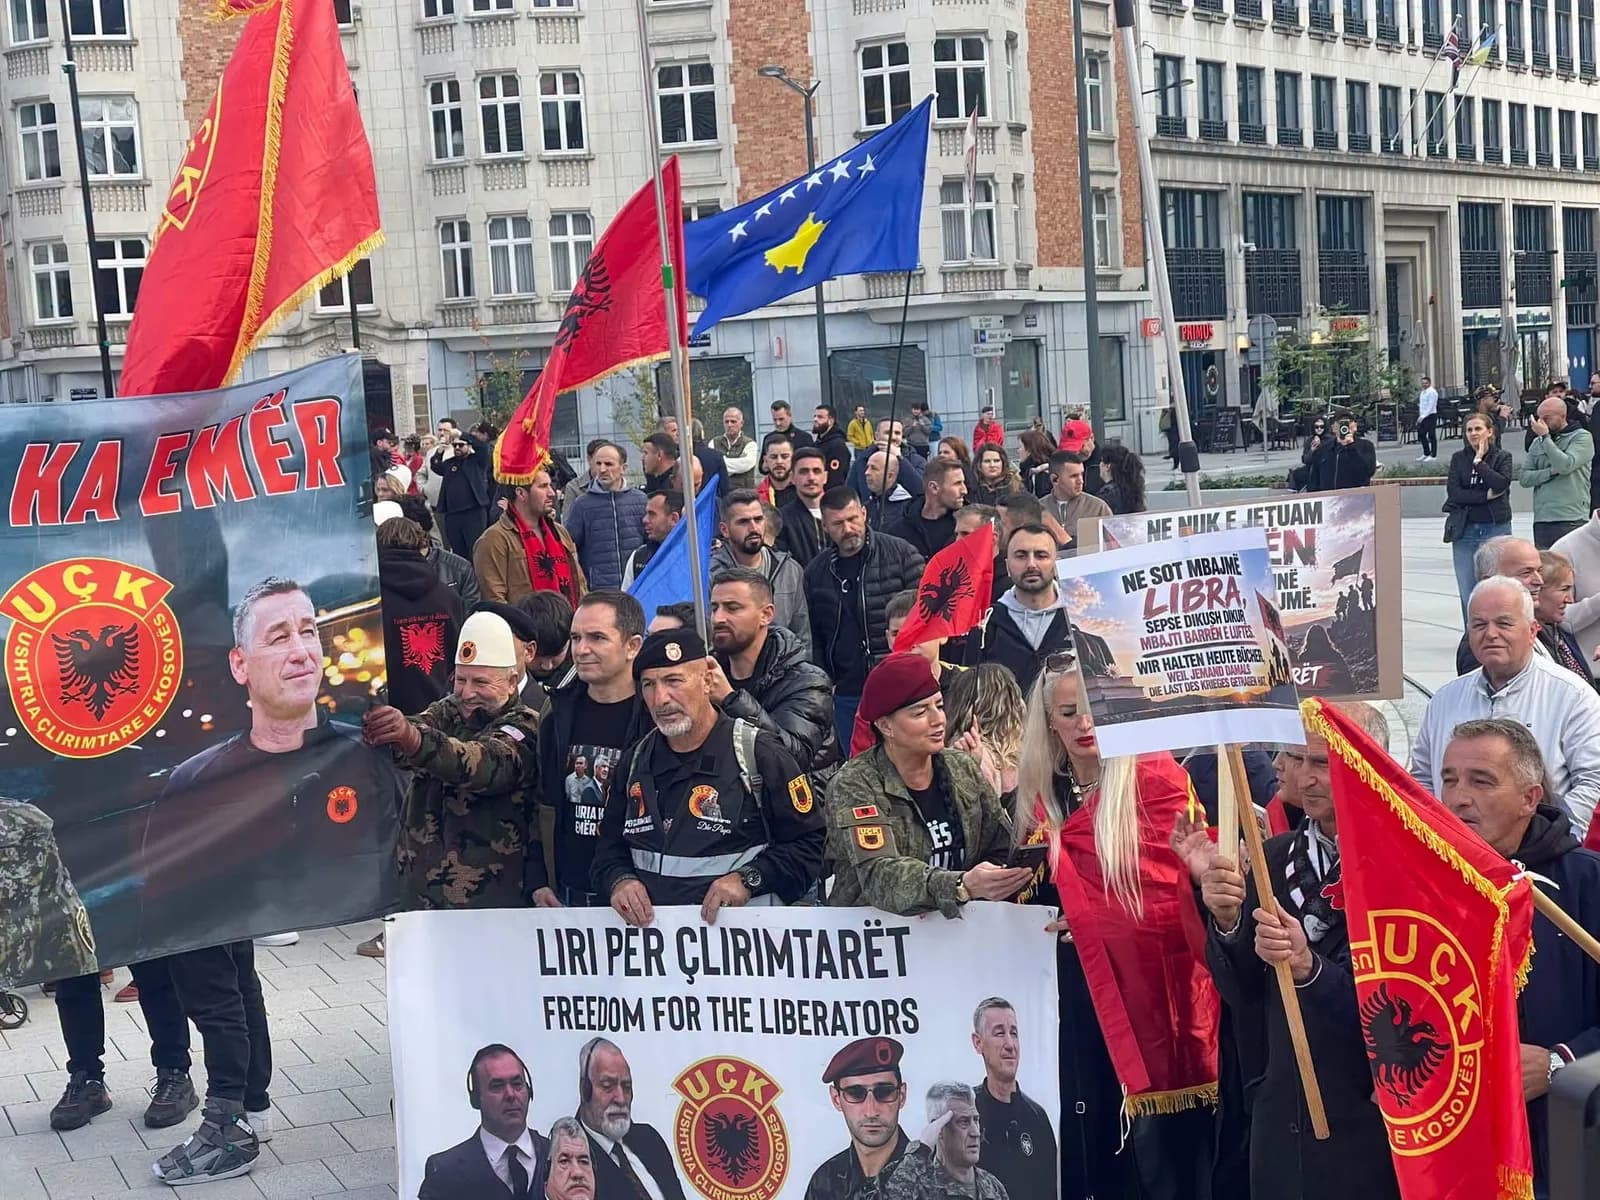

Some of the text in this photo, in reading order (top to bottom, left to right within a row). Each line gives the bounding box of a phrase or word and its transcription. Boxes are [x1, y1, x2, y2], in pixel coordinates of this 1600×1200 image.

[1181, 324, 1214, 341] PRIMUS
[9, 388, 346, 528] KA EMËR
[1146, 501, 1324, 544] NE NUK E JETUAM
[10, 564, 156, 624] UÇK
[1121, 552, 1242, 594] NE SOT MBAJMË
[1142, 575, 1247, 621] LIBRA,
[1139, 632, 1183, 651] MBAJTI
[1184, 625, 1223, 645] BARRËN
[1224, 628, 1230, 640] E
[1145, 616, 1182, 634] SEPSE
[1185, 611, 1221, 628] DIKUSH
[13, 612, 176, 750] USHTRIA ÇLIRIMTARE E KOSOVËS
[1136, 659, 1161, 676] WIR
[1163, 652, 1206, 672] HALTEN
[1206, 650, 1236, 666] HEUTE
[1166, 669, 1190, 684] WEIL
[1190, 666, 1225, 681] JEMAND
[1148, 686, 1164, 698] DIE
[1164, 682, 1184, 695] LAST
[1185, 681, 1200, 693] DES
[1201, 678, 1230, 690] KRIEGES
[536, 927, 598, 977] LIRI
[675, 919, 911, 985] ÇLIRIMTARËT
[1383, 922, 1482, 1036] UÇK
[543, 995, 920, 1037] FREEDOM FOR THE LIBERATORS
[682, 1062, 771, 1106] UÇK
[1411, 1053, 1475, 1146] KOSOVËS
[679, 1108, 697, 1173] USHTRIA
